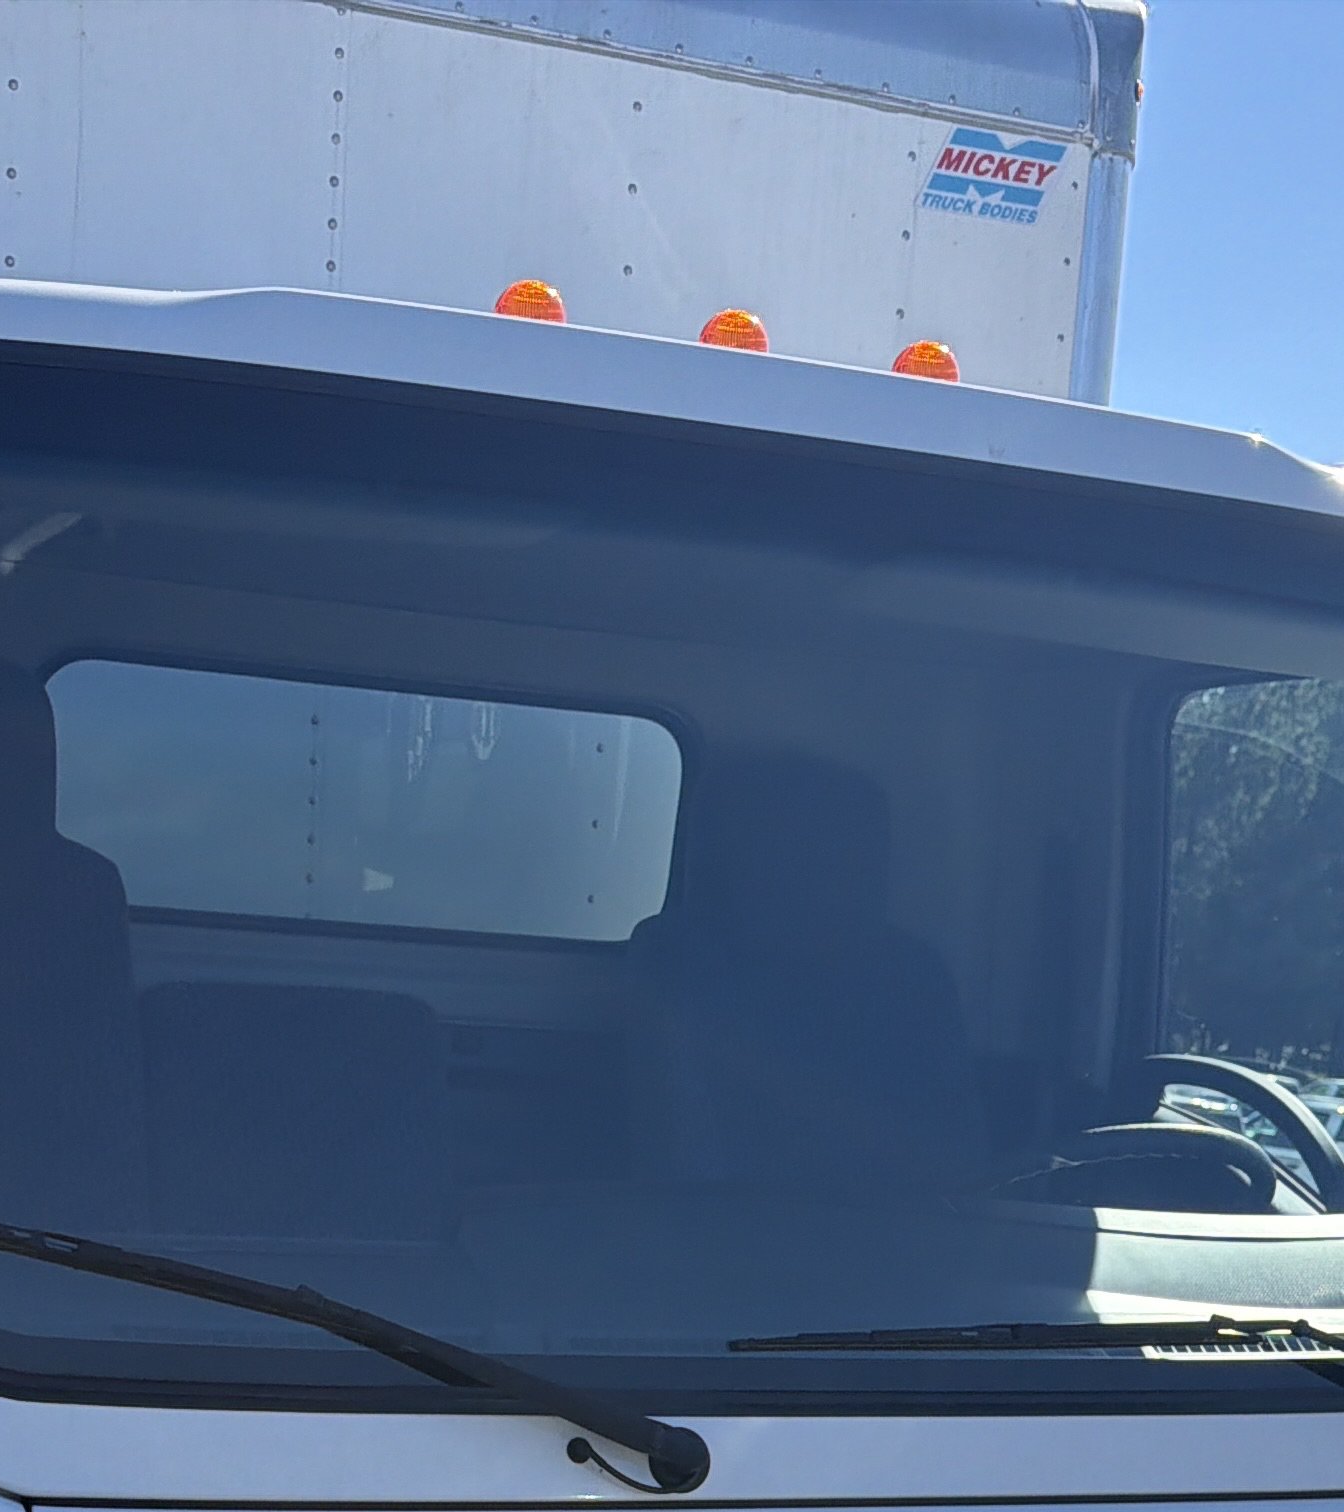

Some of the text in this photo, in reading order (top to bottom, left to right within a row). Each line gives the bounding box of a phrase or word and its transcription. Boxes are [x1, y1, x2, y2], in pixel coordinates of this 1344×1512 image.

[936, 148, 1057, 186] MICKEY
[922, 193, 1037, 223] TRUCK BODIES
